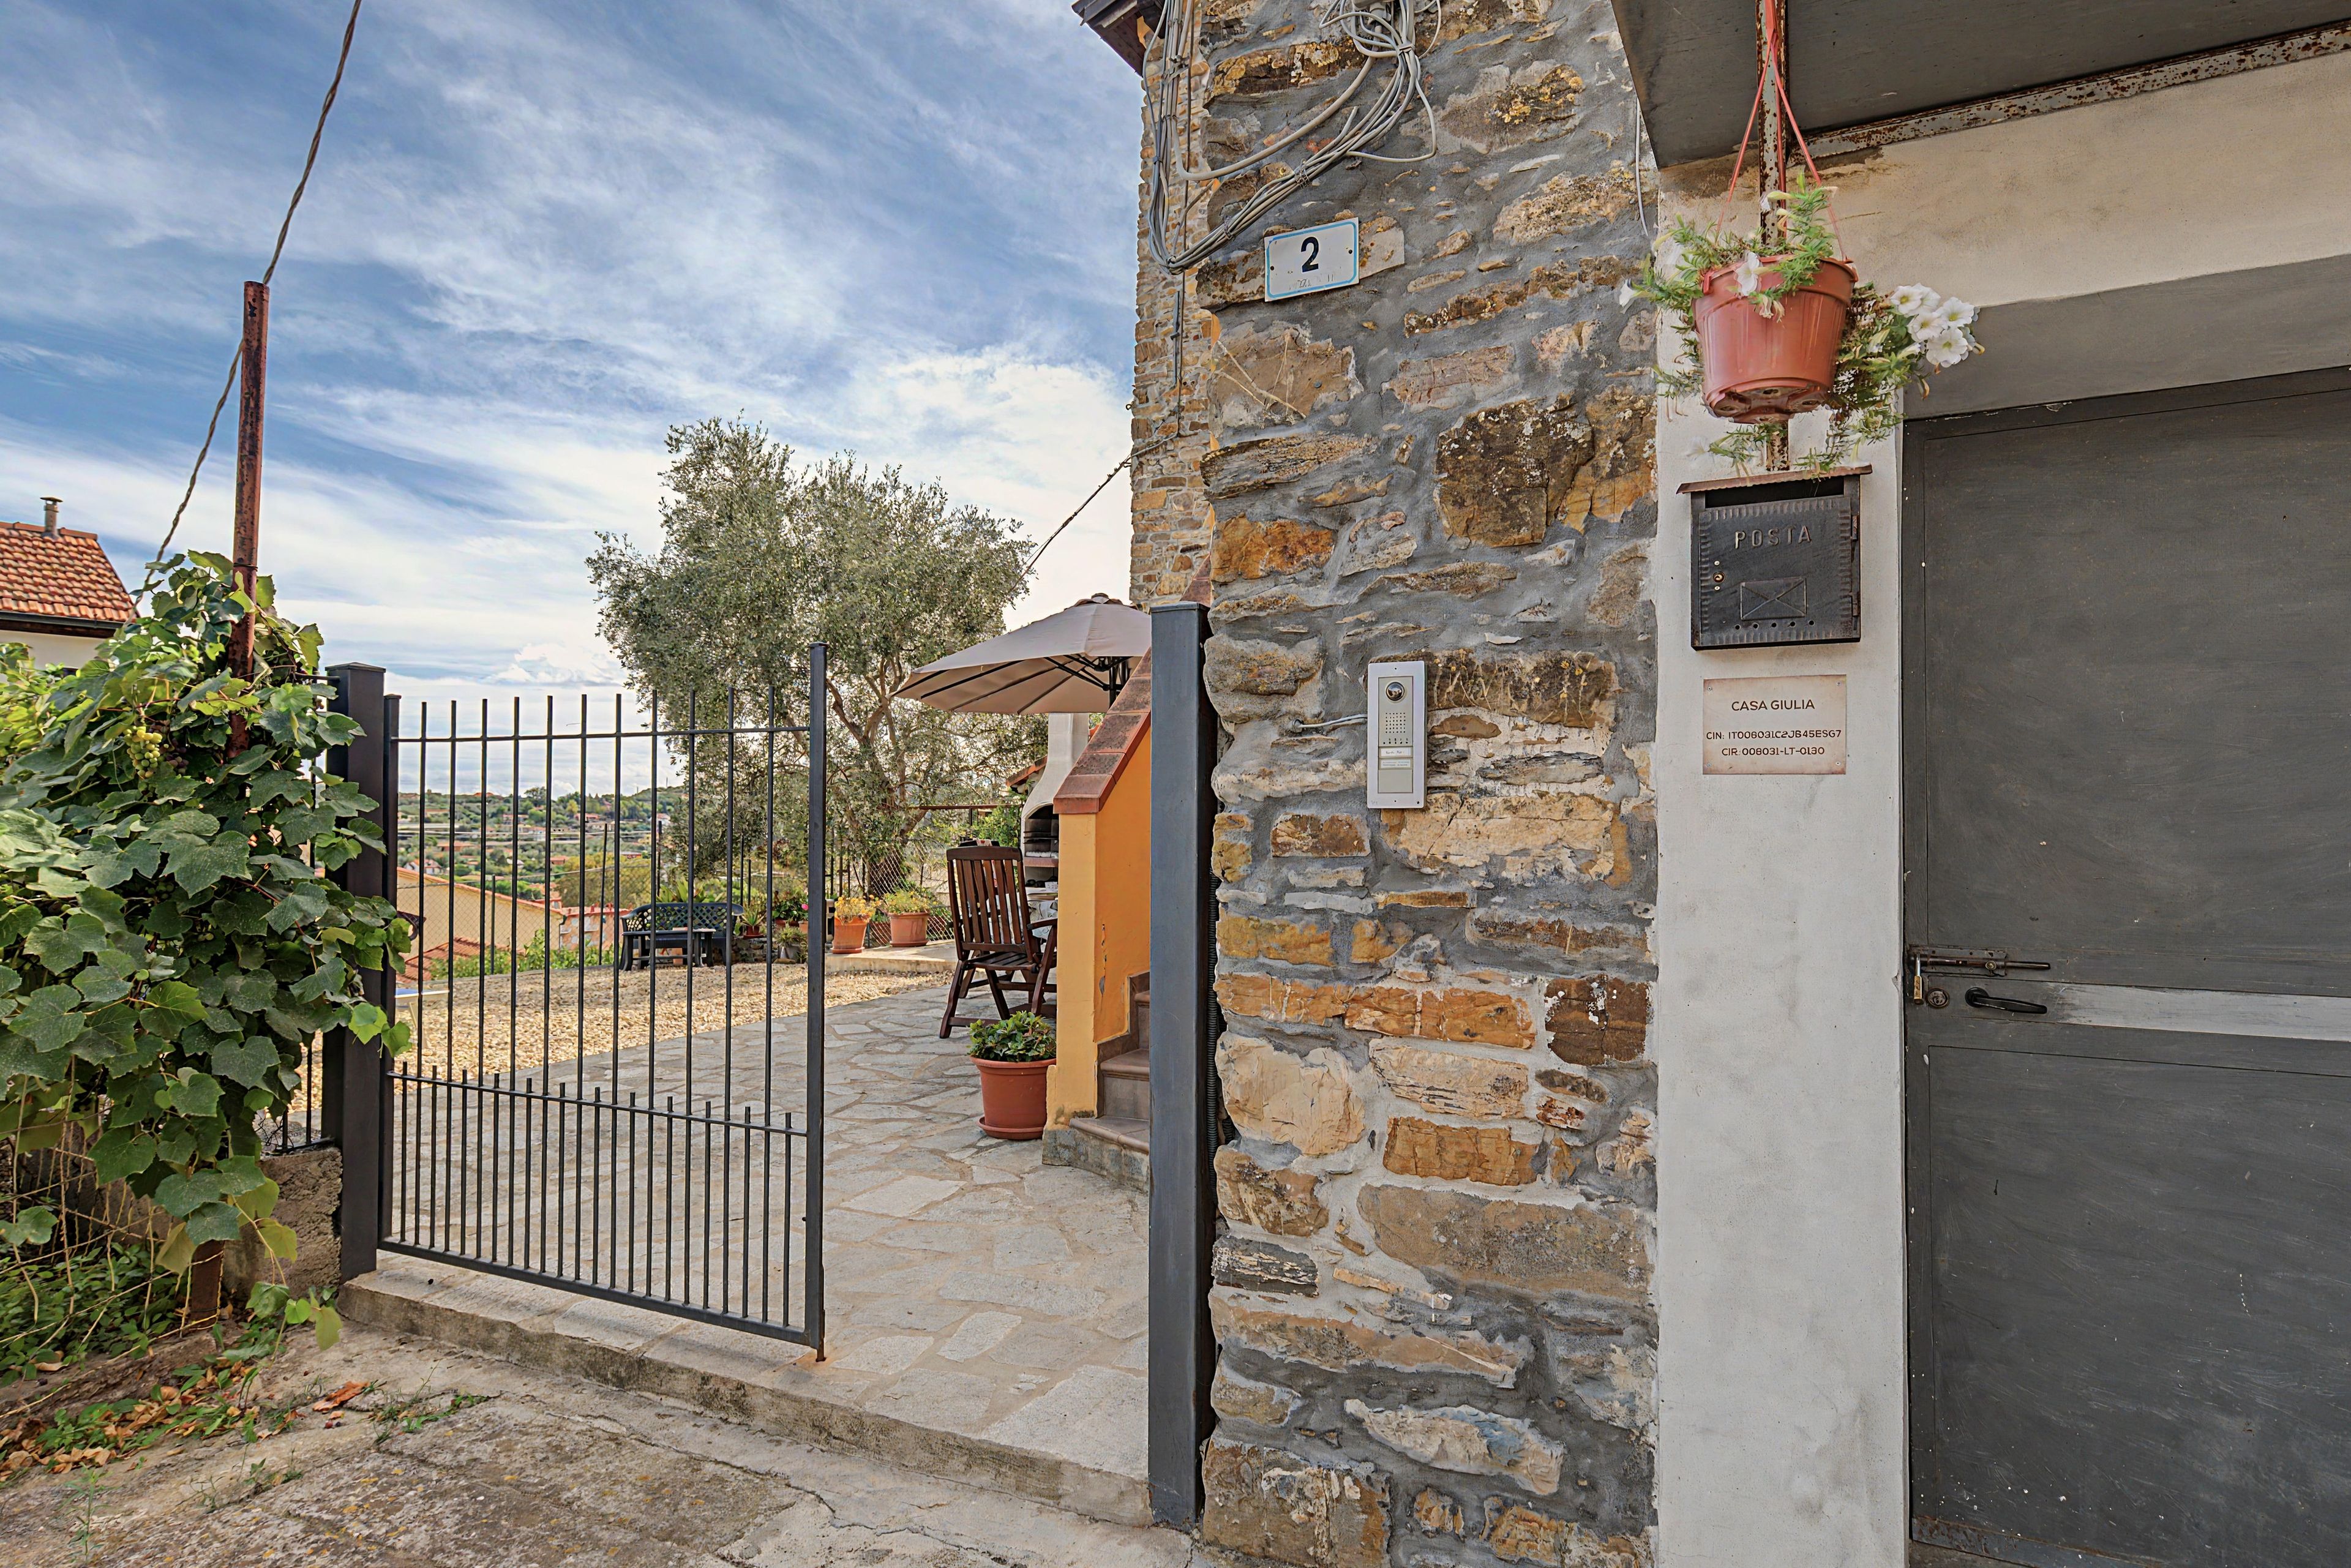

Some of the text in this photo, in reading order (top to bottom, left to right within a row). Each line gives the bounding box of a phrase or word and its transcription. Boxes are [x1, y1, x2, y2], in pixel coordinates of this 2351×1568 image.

[1301, 236, 1319, 272] 2
[1734, 525, 1812, 549] POSTA
[1731, 699, 1815, 711] CASA GIULIA
[1706, 731, 1724, 740] CIN:
